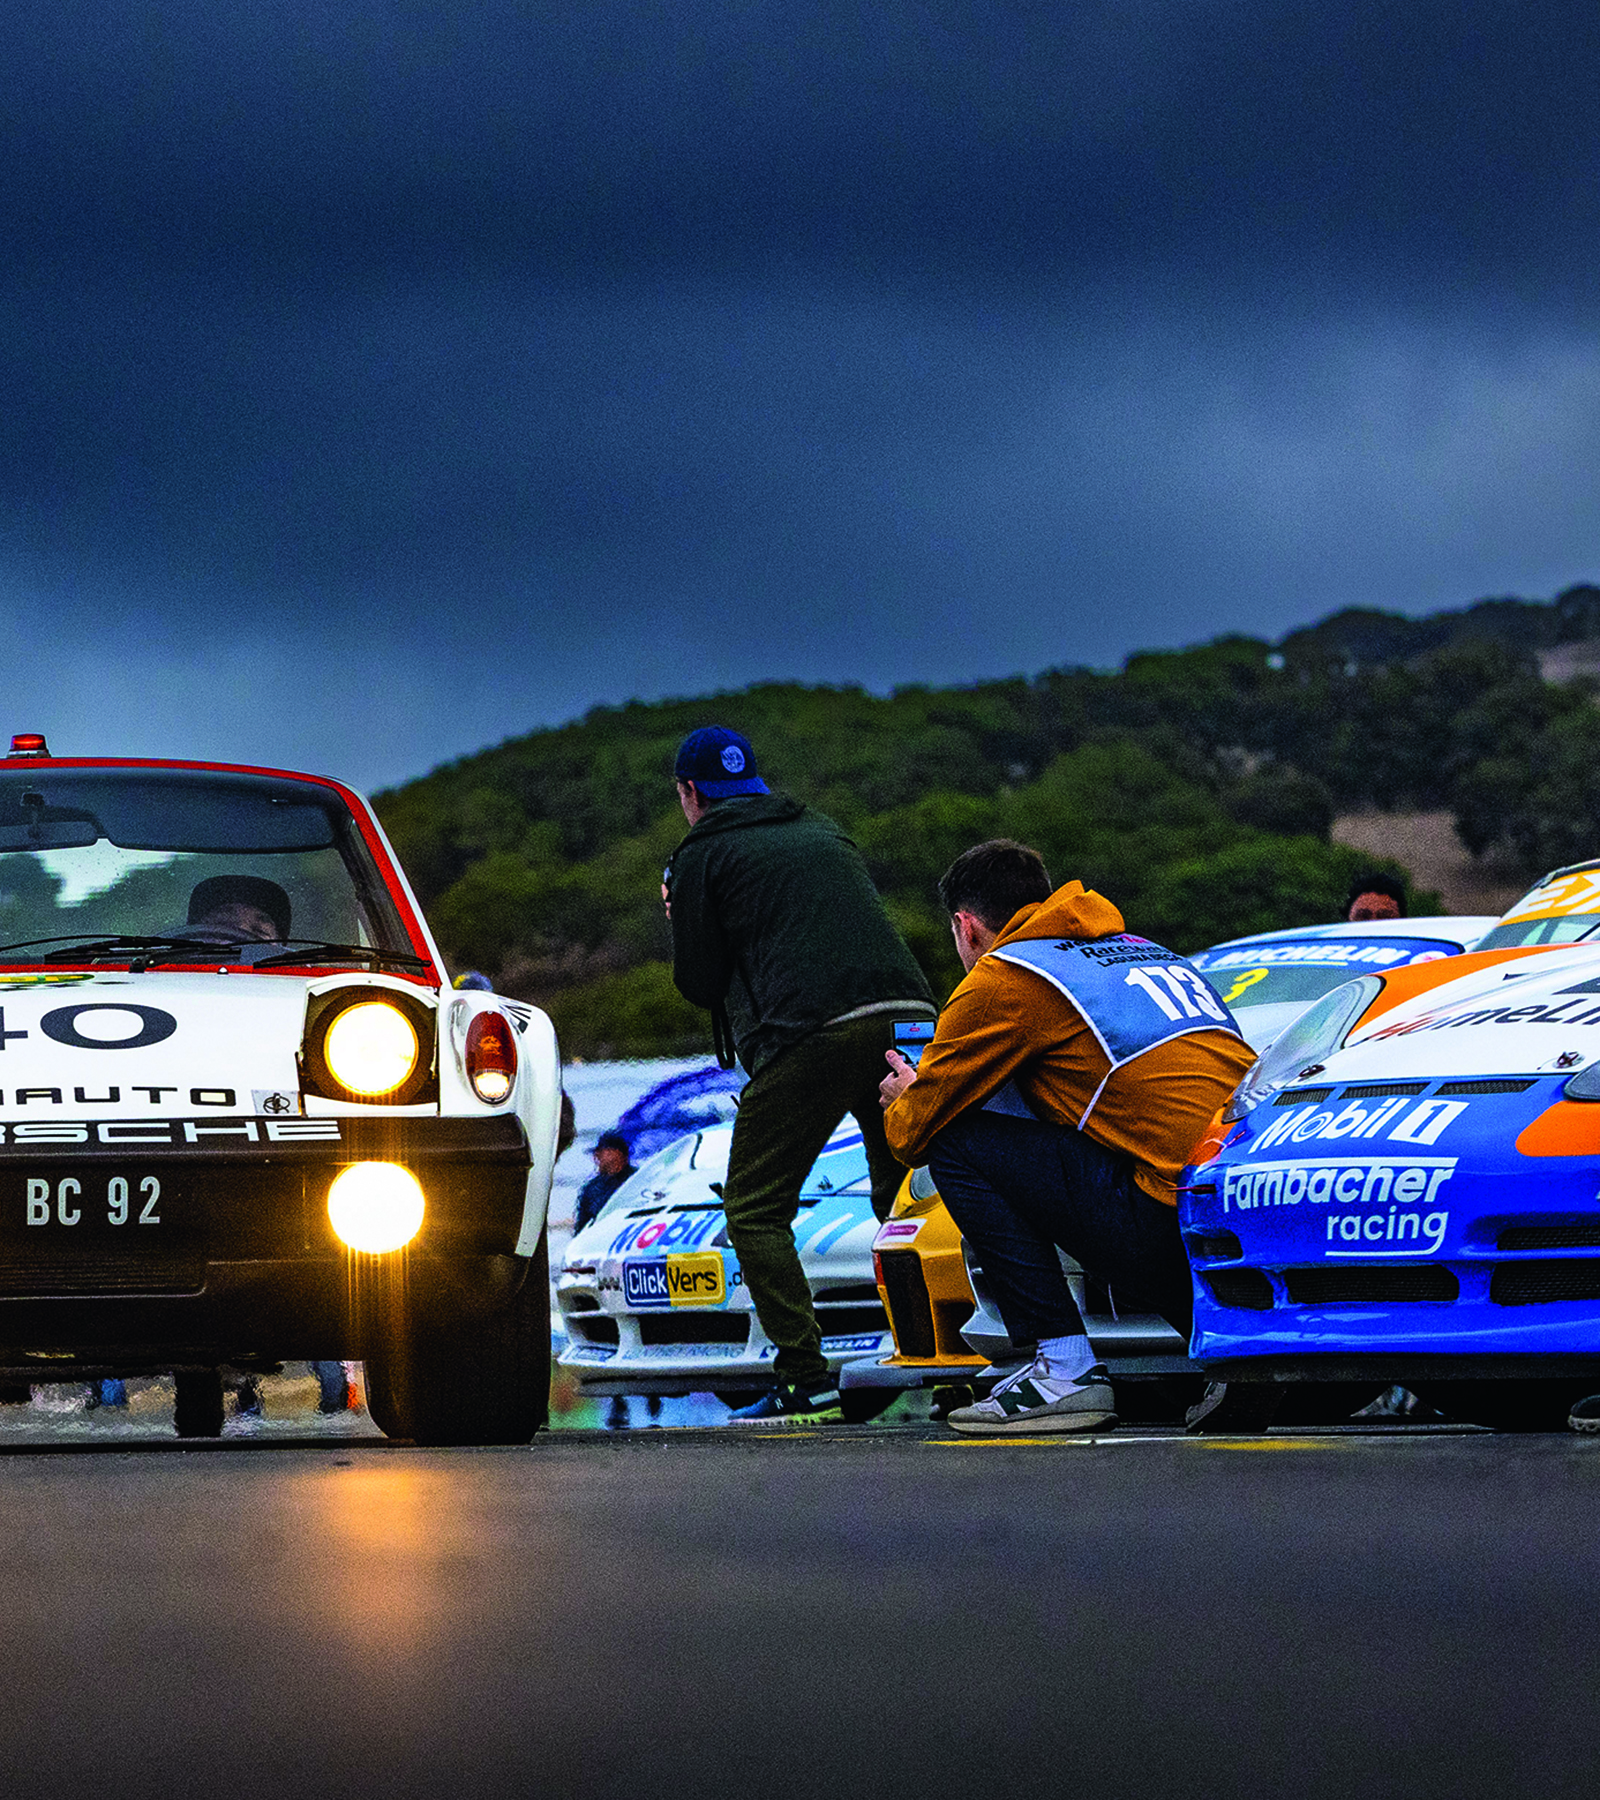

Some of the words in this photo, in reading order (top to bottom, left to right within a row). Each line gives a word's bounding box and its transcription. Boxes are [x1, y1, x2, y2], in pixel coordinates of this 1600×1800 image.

[1209, 945, 1411, 965] MICHELIN
[1124, 965, 1228, 1021] 173
[1248, 1098, 1411, 1154] Mobil
[27, 1177, 82, 1226] BC
[107, 1176, 161, 1226] 92
[1223, 1157, 1459, 1213] Farnbacher
[608, 1212, 724, 1256] Mobil
[1326, 1206, 1449, 1257] racing
